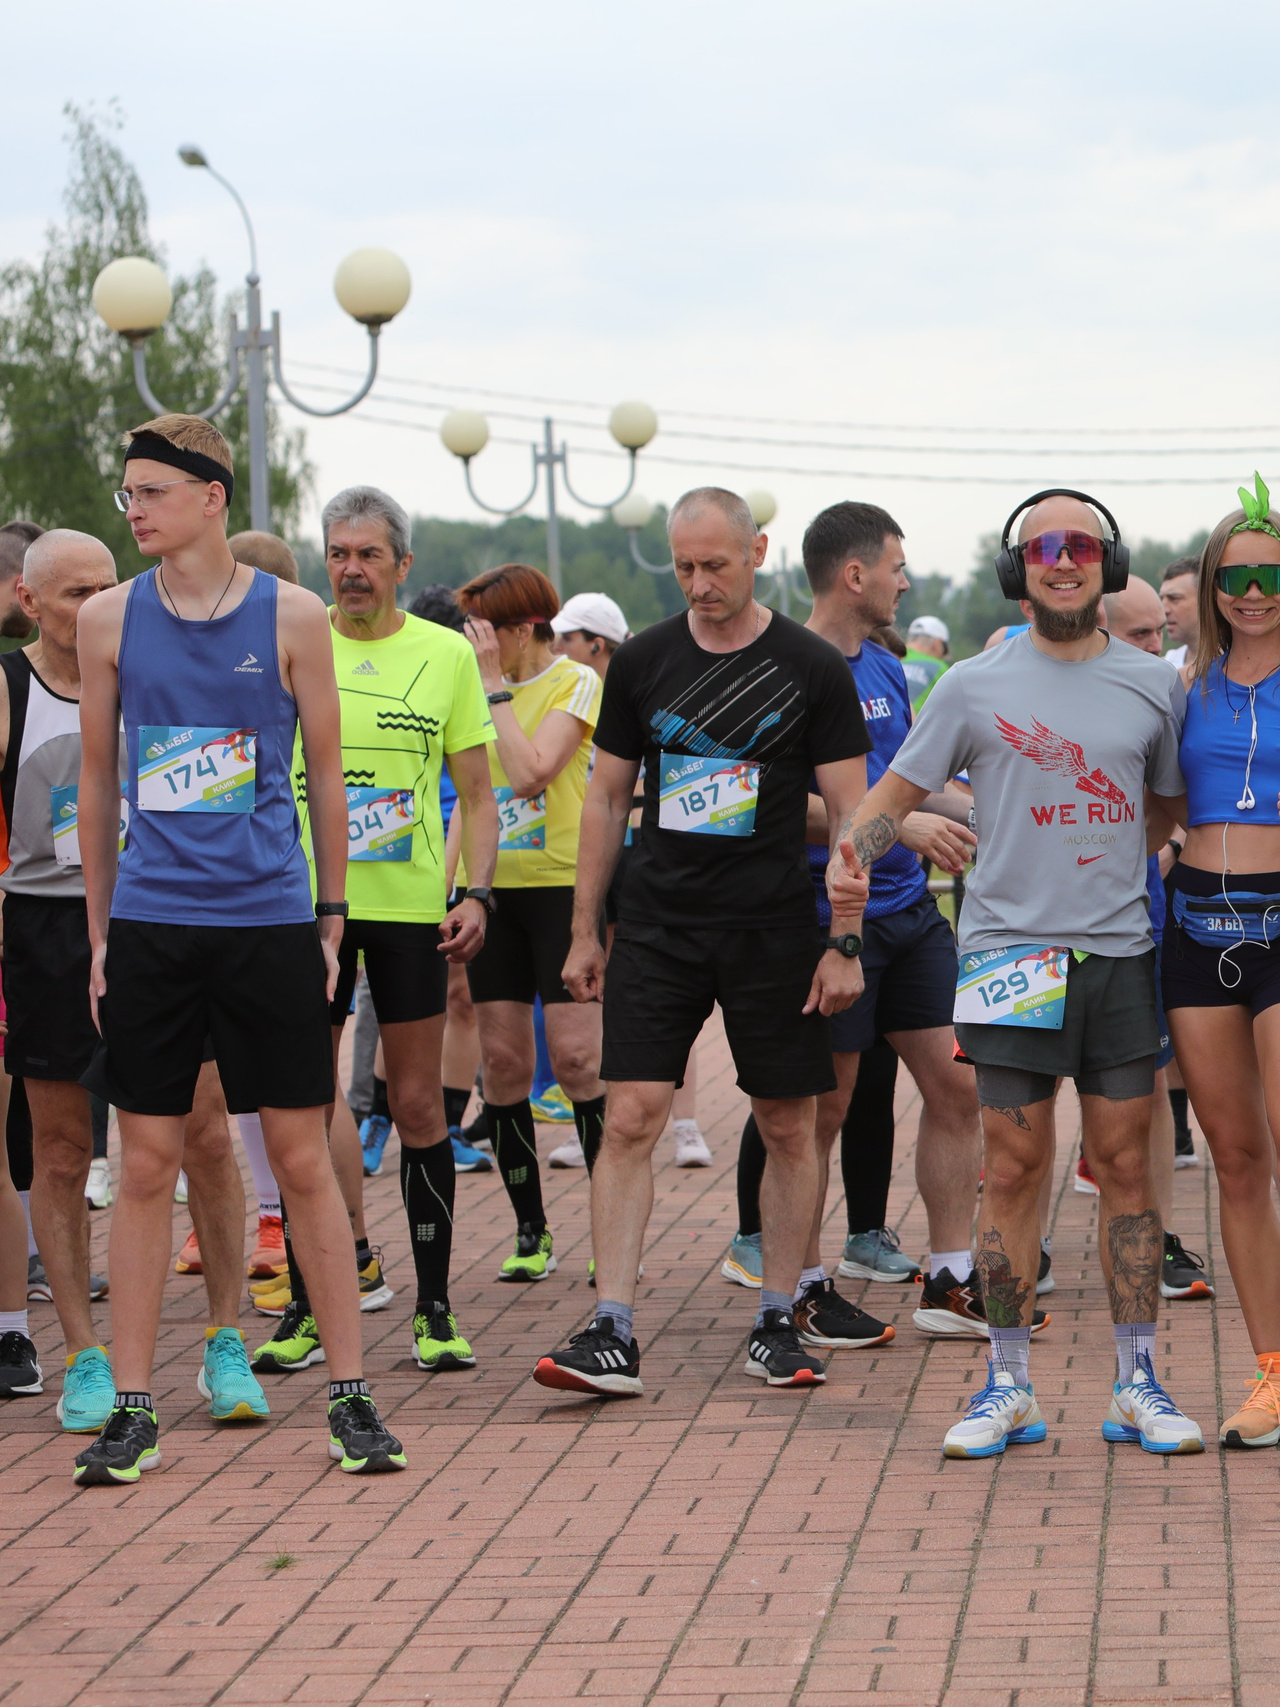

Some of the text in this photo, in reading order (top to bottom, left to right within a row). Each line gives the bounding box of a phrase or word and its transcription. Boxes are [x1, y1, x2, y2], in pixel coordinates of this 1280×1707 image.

[233, 666, 264, 674] DEMIX
[352, 668, 379, 676] adidas
[163, 755, 218, 794] 174
[212, 779, 237, 794] КЛИН
[678, 783, 719, 816] 187
[717, 805, 740, 818] КЛИН
[1030, 802, 1135, 826] WE RUN
[376, 832, 397, 845] КЛИН
[1063, 833, 1117, 846] MOSCOW
[978, 970, 1029, 1008] 129
[1022, 994, 1047, 1008] КЛИН
